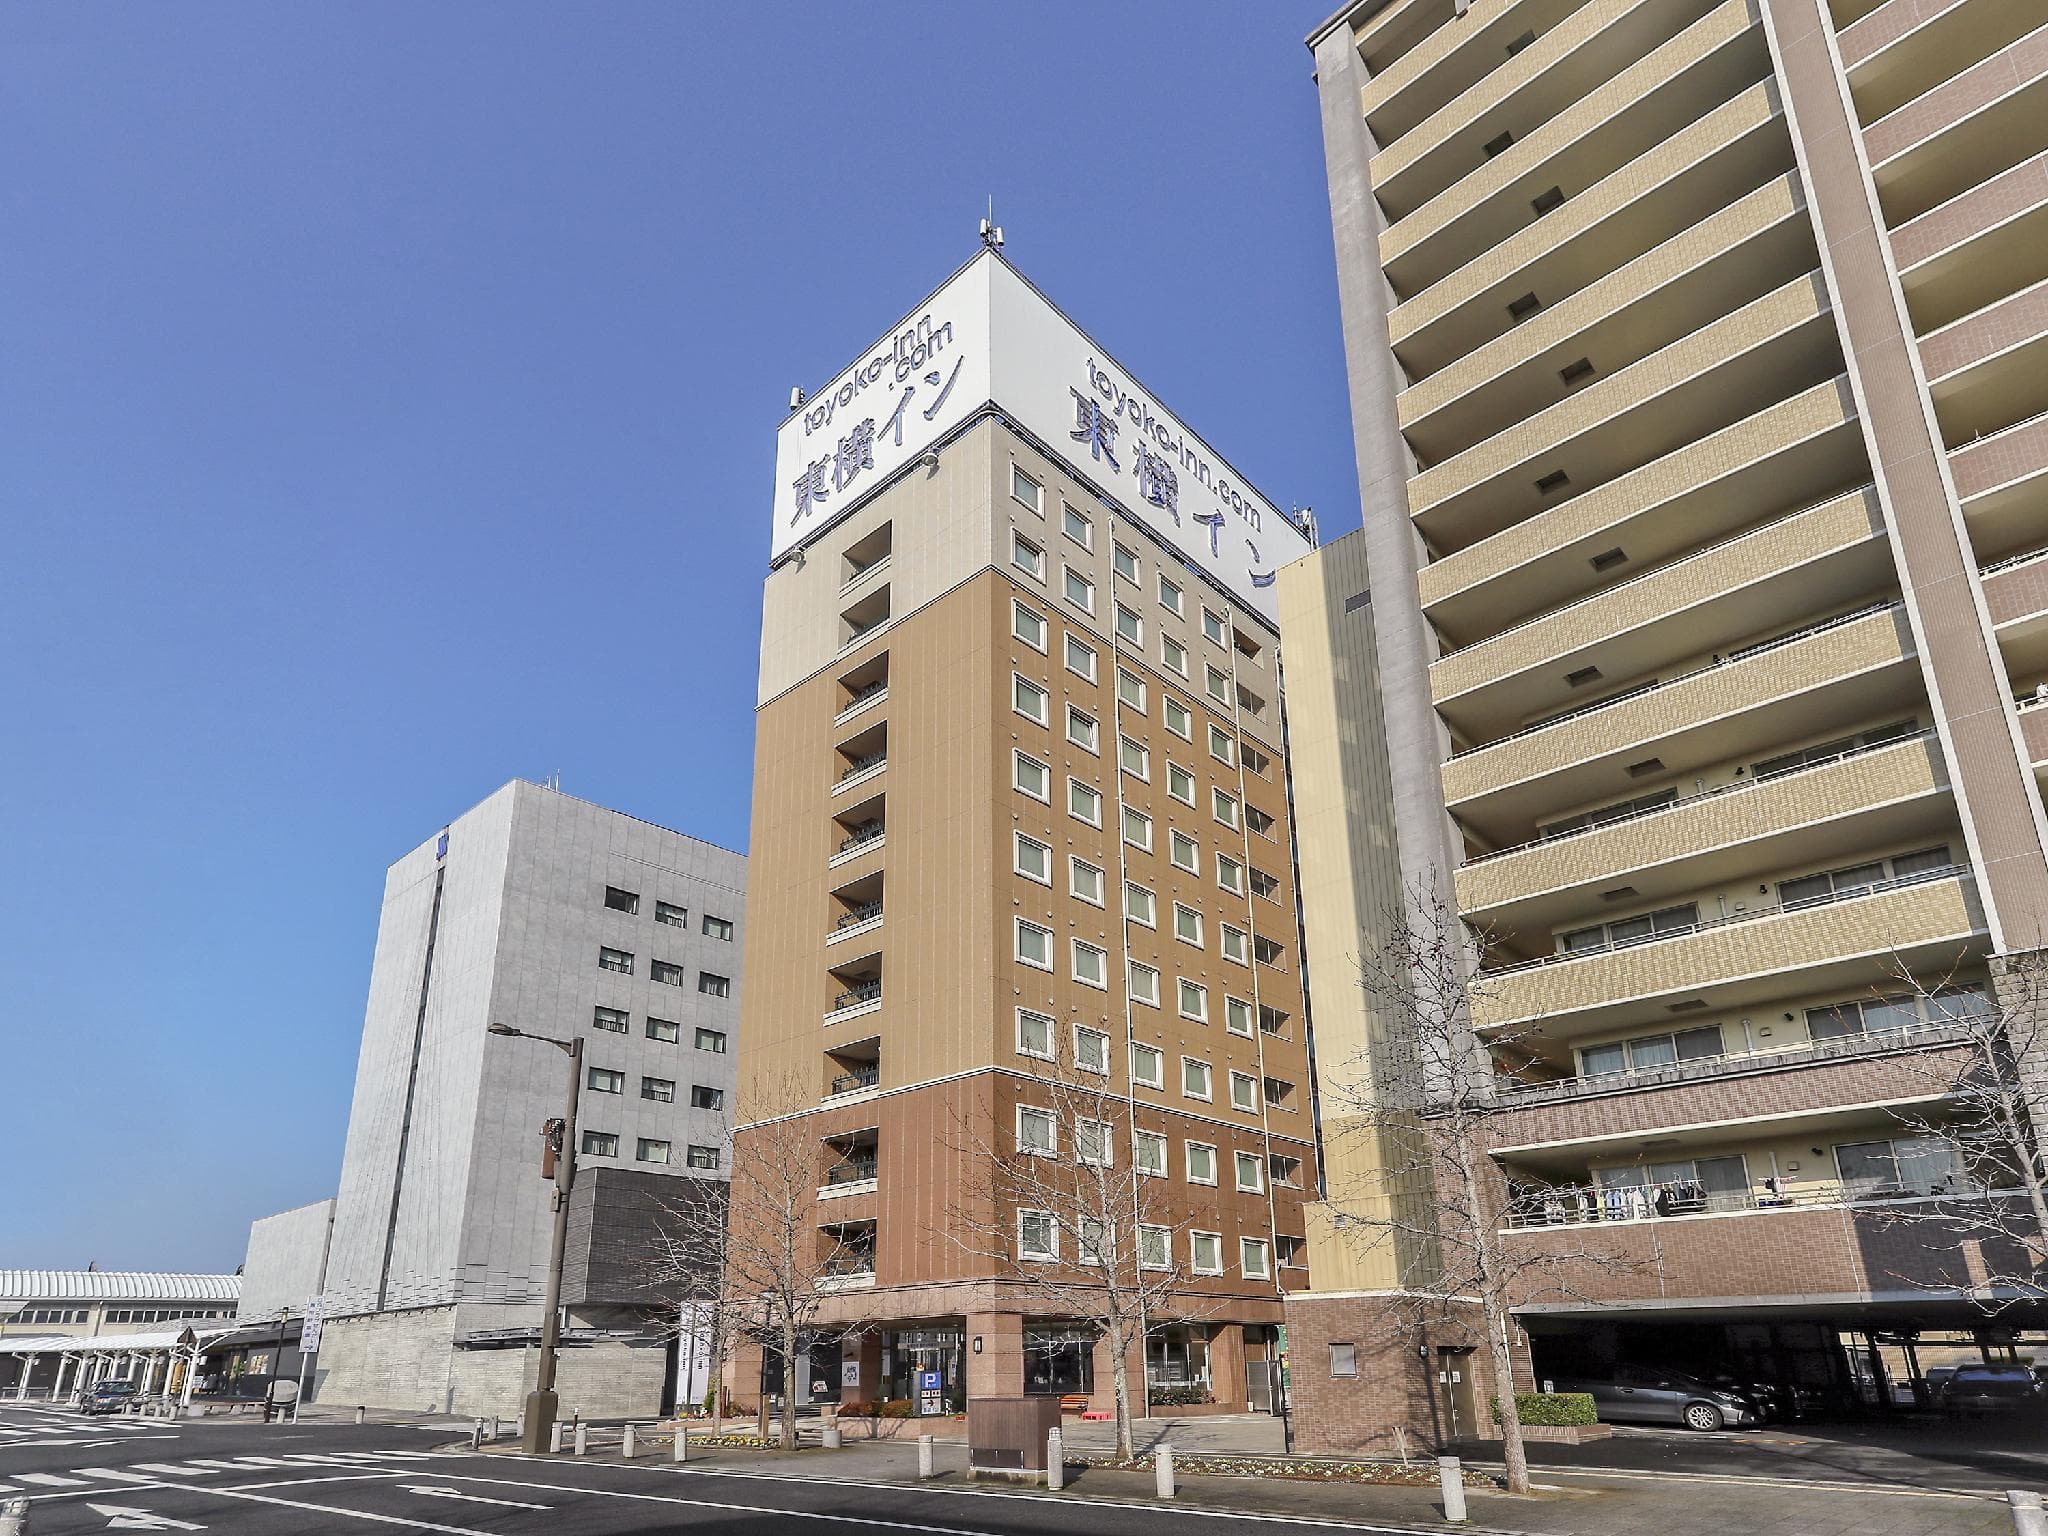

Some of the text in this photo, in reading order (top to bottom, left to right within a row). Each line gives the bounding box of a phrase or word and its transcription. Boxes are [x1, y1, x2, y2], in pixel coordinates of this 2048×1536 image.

[791, 354, 965, 528] 東横イン
[804, 314, 932, 436] toyoko-inn
[1086, 357, 1262, 534] toyoko-inn.com
[1070, 385, 1276, 588] 東横イン
[925, 1373, 937, 1388] P
